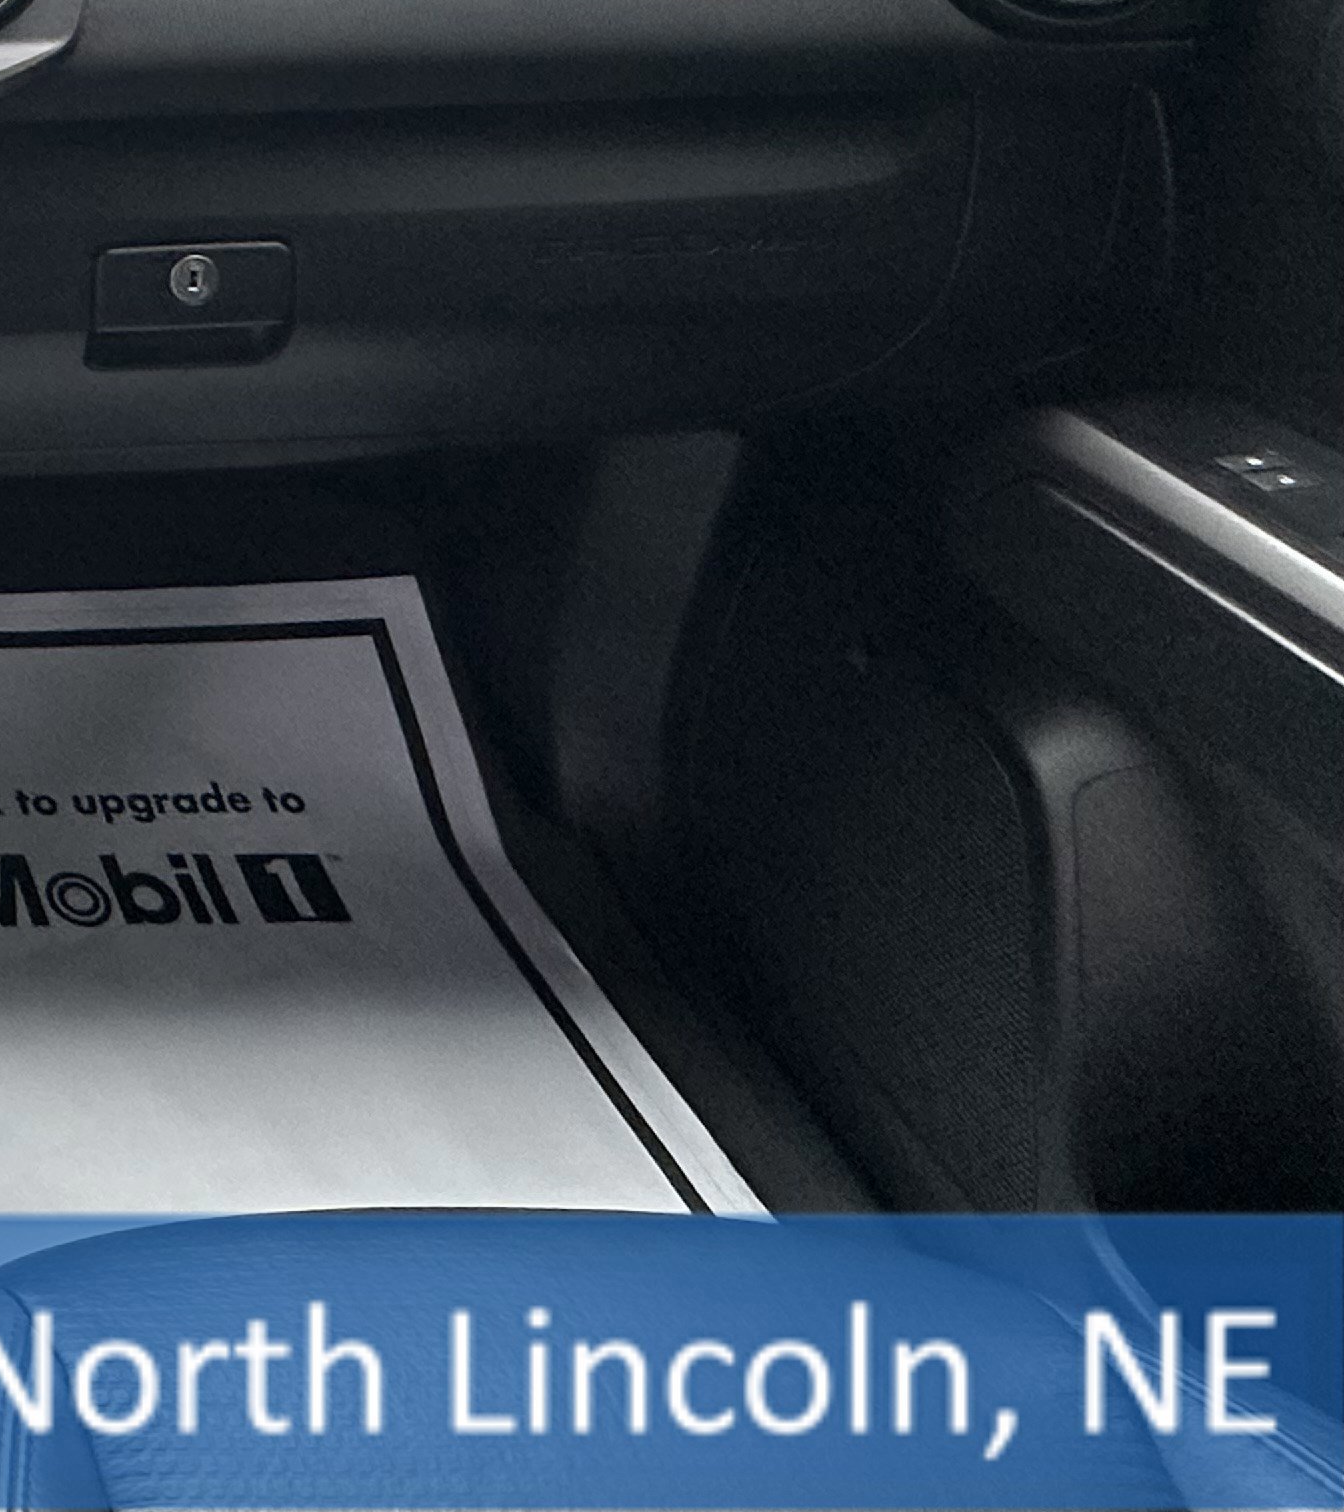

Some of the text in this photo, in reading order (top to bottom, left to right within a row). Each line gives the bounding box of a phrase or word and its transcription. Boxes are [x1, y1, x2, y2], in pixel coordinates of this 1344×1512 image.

[15, 789, 58, 817] to
[73, 781, 252, 824] upgrade
[262, 787, 306, 815] to
